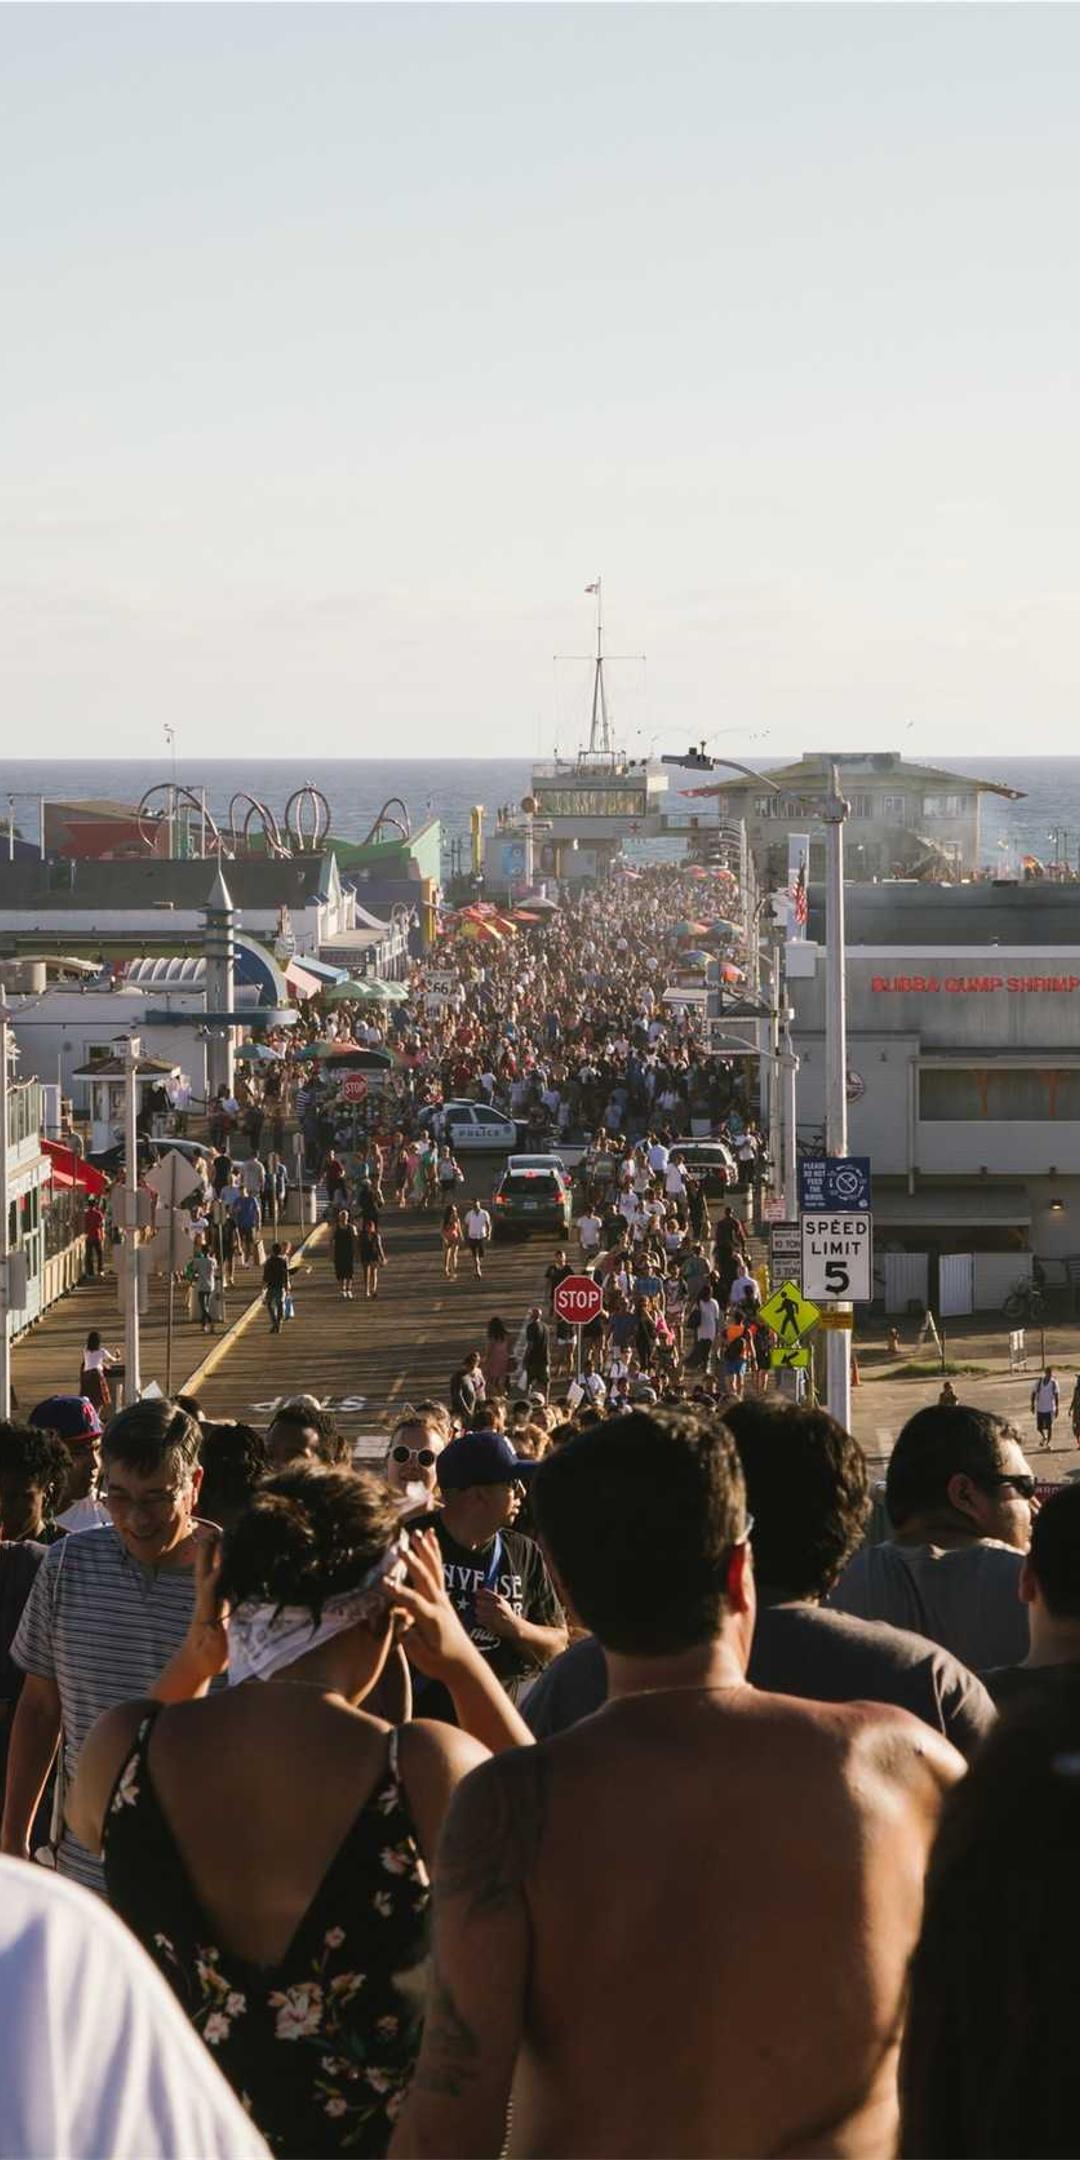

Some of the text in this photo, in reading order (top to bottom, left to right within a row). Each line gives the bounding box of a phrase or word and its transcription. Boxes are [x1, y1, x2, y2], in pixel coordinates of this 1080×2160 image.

[871, 975, 1080, 993] BUBBA GUMP SHRIMP
[344, 1081, 366, 1095] STOP
[458, 1128, 500, 1138] POLICE
[805, 1221, 867, 1235] SPEED
[775, 1240, 783, 1249] 10
[811, 1242, 861, 1255] LIMIT
[825, 1261, 850, 1293] 5
[558, 1290, 599, 1309] STOP
[246, 1396, 368, 1412] STP
[443, 1563, 524, 1599] NVESE
